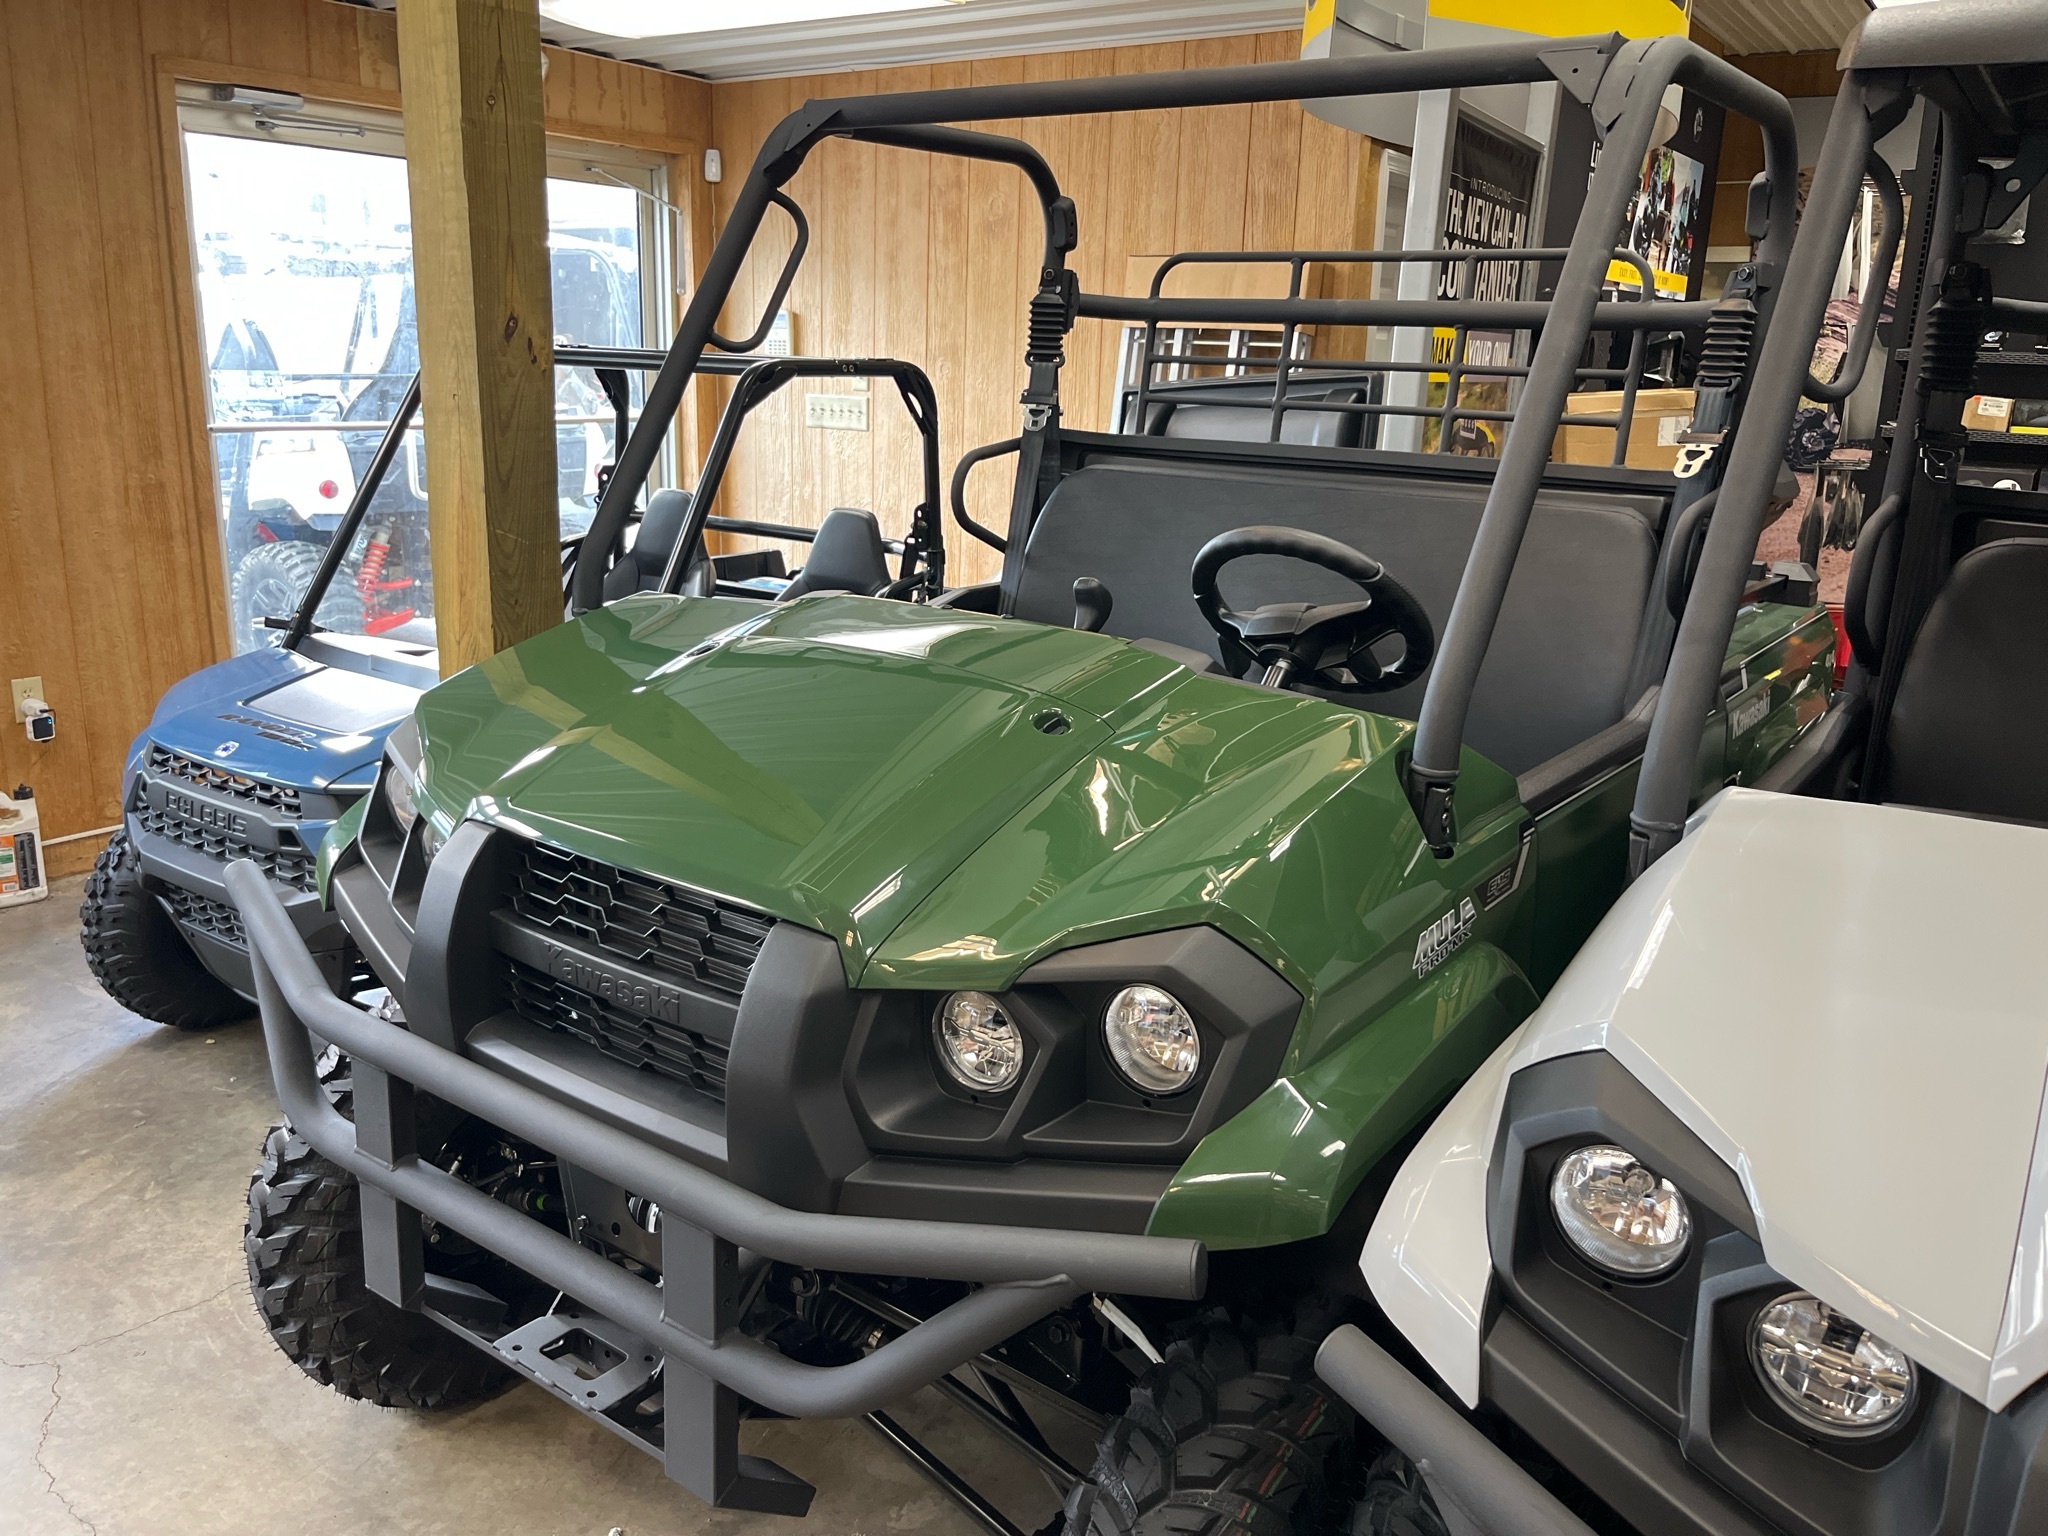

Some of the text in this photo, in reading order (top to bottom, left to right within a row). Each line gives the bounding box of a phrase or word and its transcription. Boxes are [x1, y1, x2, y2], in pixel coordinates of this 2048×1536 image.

[1444, 187, 1465, 236] THE
[1463, 195, 1493, 243] NEW
[1469, 177, 1513, 204] INTRODUCING
[1430, 336, 1511, 368] MAK YOUR OWN
[1732, 688, 1771, 740] Kawasaki
[165, 790, 248, 838] POLARIS
[1412, 896, 1477, 970] MULE
[1418, 923, 1473, 980] PRO-MX
[543, 941, 681, 1024] Kawasaki
